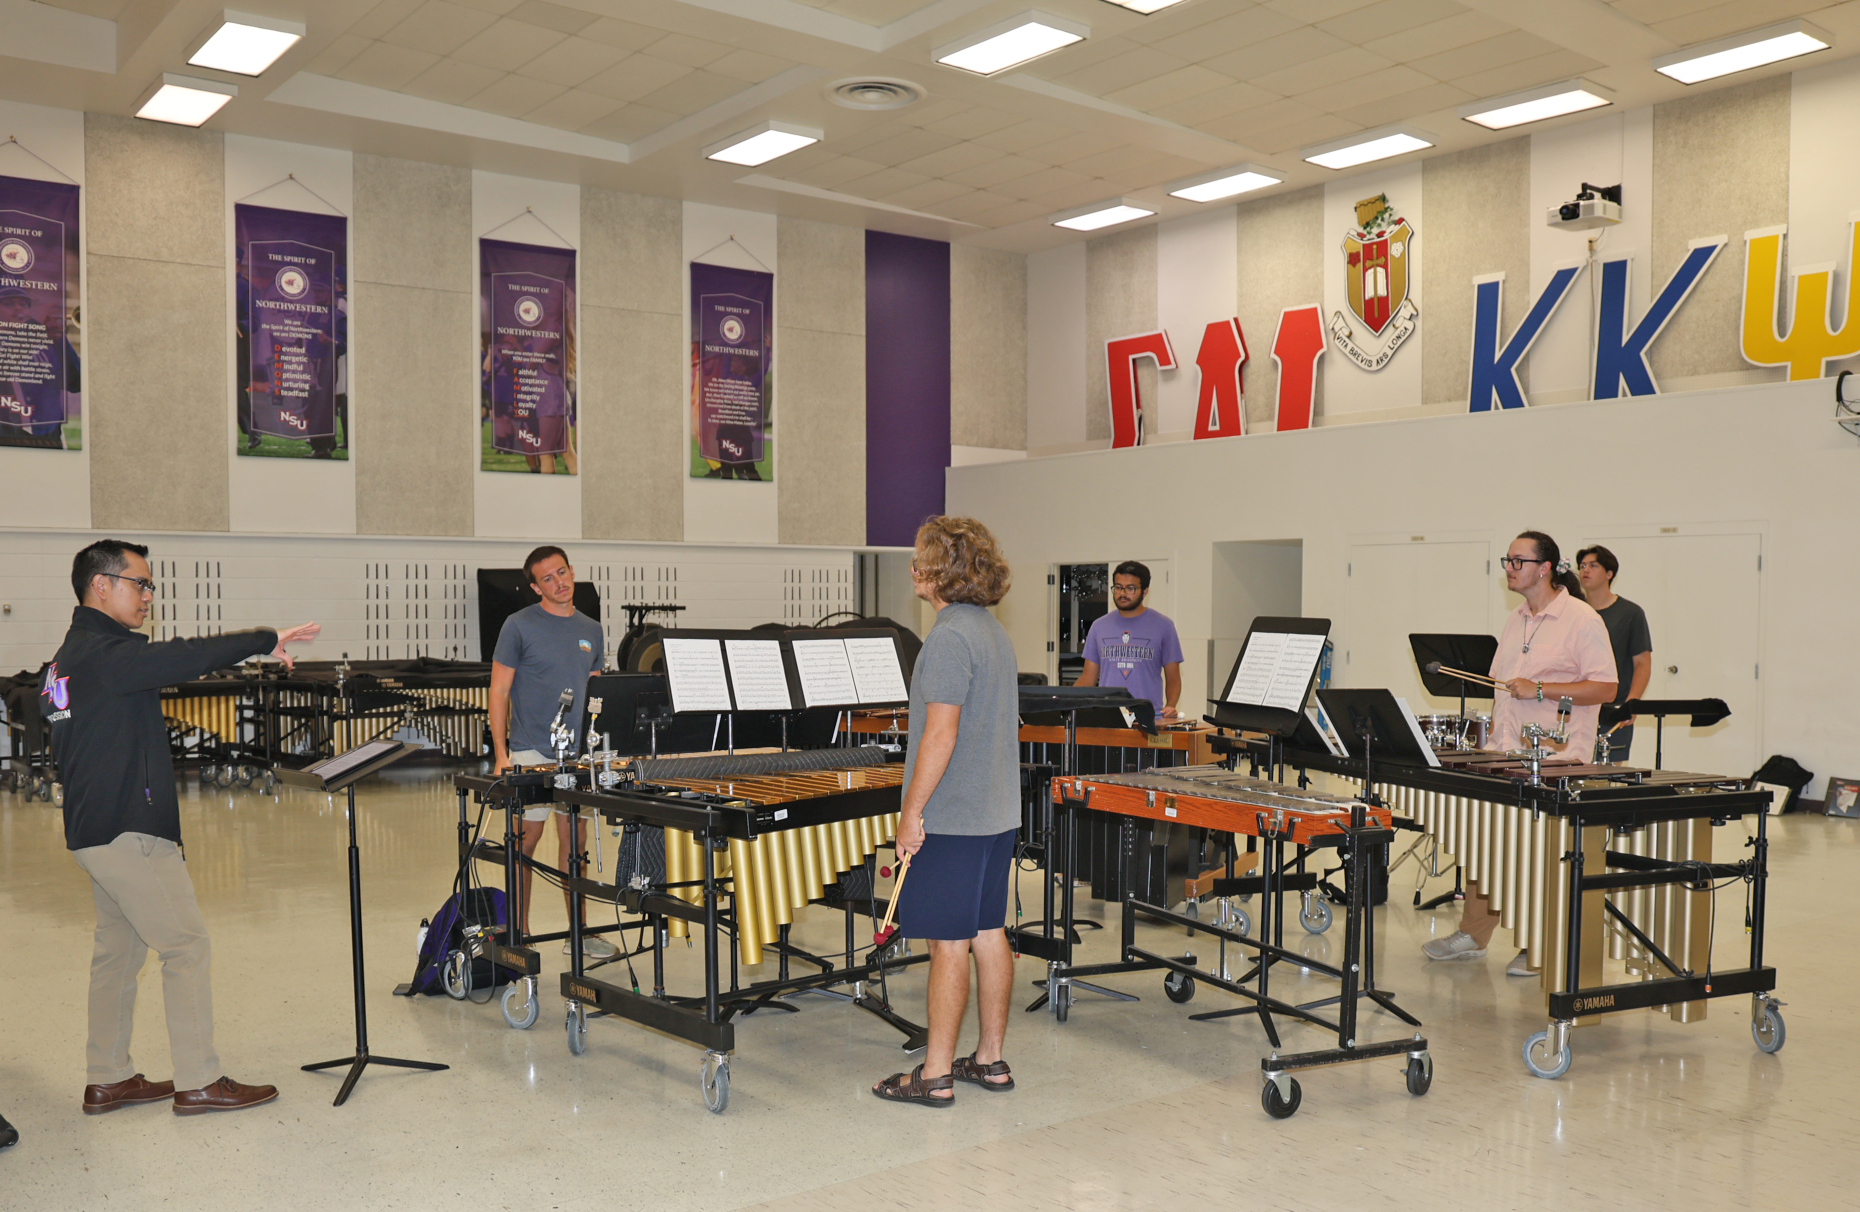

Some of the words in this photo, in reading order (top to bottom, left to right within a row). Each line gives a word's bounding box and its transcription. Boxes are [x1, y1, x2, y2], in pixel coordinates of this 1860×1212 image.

[4, 226, 31, 236] SPIRIT
[268, 253, 282, 261] THE
[284, 255, 305, 264] SPIRIT
[521, 285, 540, 293] SPIRIT
[255, 299, 329, 314] NORTHWESTERN
[28, 323, 46, 331] SONG
[497, 326, 560, 339] NORTHWESTERN
[705, 345, 759, 356] NORTHWESTERN
[1336, 333, 1349, 349] VITA
[1348, 347, 1373, 368] BREVIS
[1376, 351, 1389, 367] ARS
[1388, 326, 1410, 351] LONGA
[1, 396, 32, 416] NSU
[280, 411, 307, 430] NSU
[519, 429, 541, 446] NSU
[722, 440, 742, 456] NSU
[507, 951, 526, 968] YAMAHA
[1583, 994, 1615, 1010] YAMAHA
